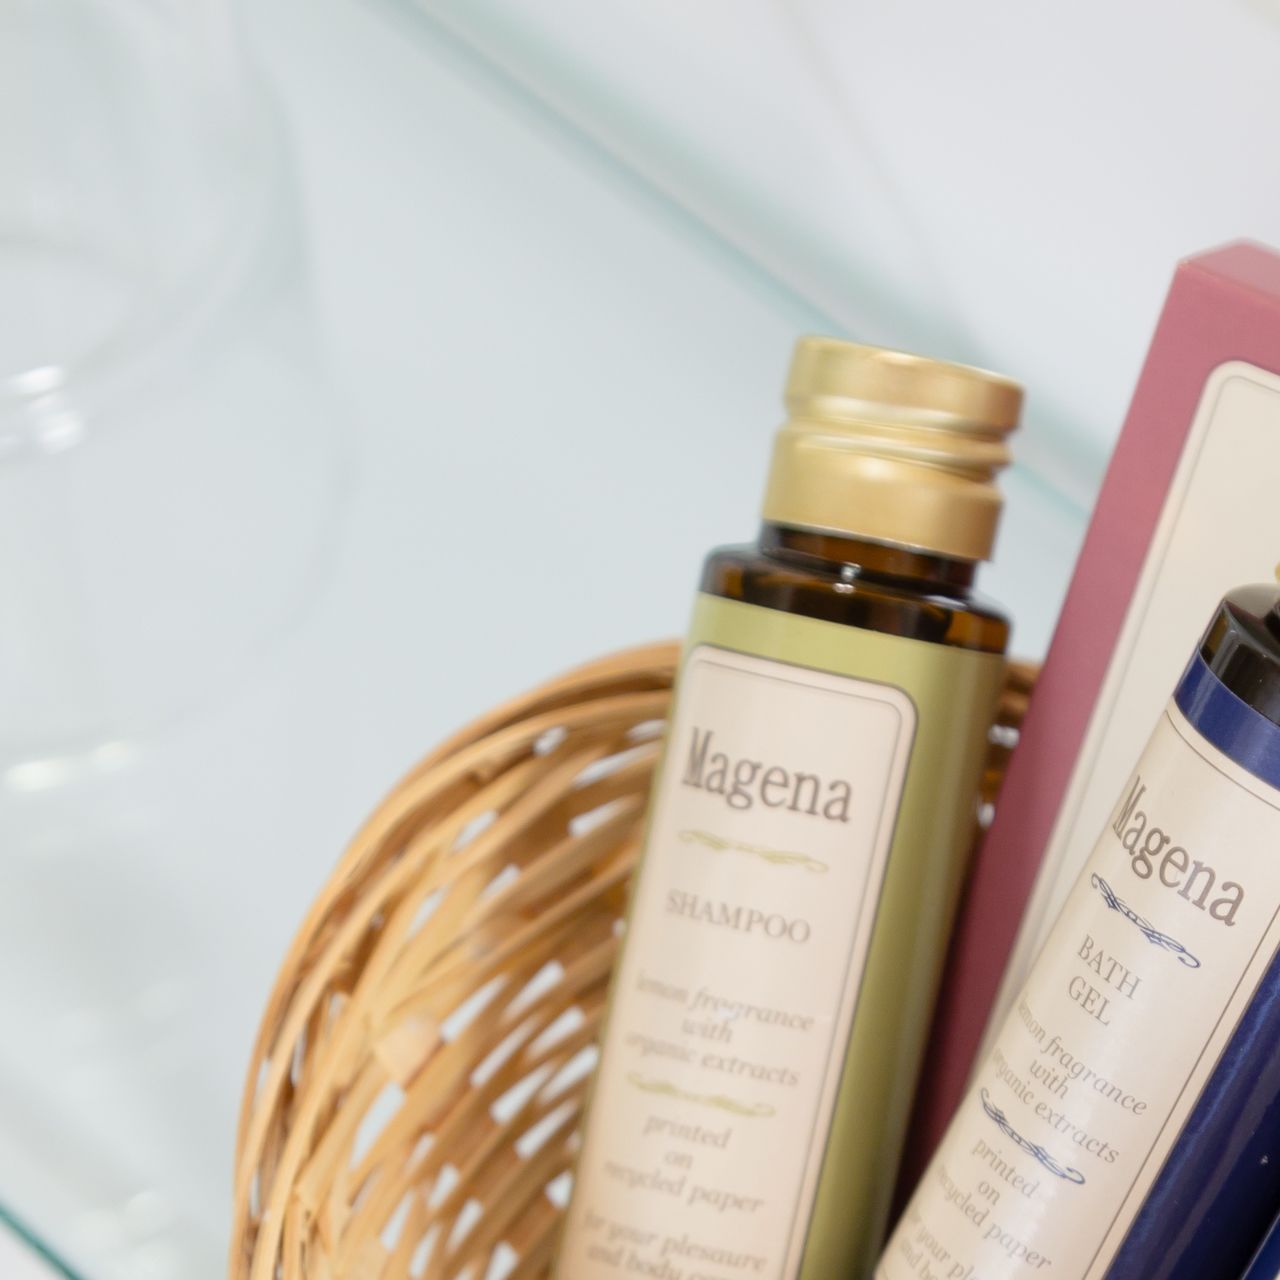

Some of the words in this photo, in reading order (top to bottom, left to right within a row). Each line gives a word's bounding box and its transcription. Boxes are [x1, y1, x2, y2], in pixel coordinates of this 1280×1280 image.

[681, 726, 853, 824] Magena
[1111, 775, 1246, 927] Magena
[664, 888, 812, 944] SHAMPOO
[1076, 934, 1143, 1000] BATH
[1067, 975, 1110, 1026] GEL
[681, 1016, 734, 1044] with
[701, 1053, 801, 1088] extracts
[1029, 1059, 1069, 1100] with
[1040, 1036, 1148, 1116] fragrance
[643, 1115, 733, 1149] printed
[1034, 1101, 1120, 1164] extracts
[664, 1151, 694, 1169] on
[971, 1138, 1040, 1199] printed
[687, 1185, 765, 1213] paper
[978, 1180, 1001, 1206] on
[983, 1223, 1052, 1270] paper
